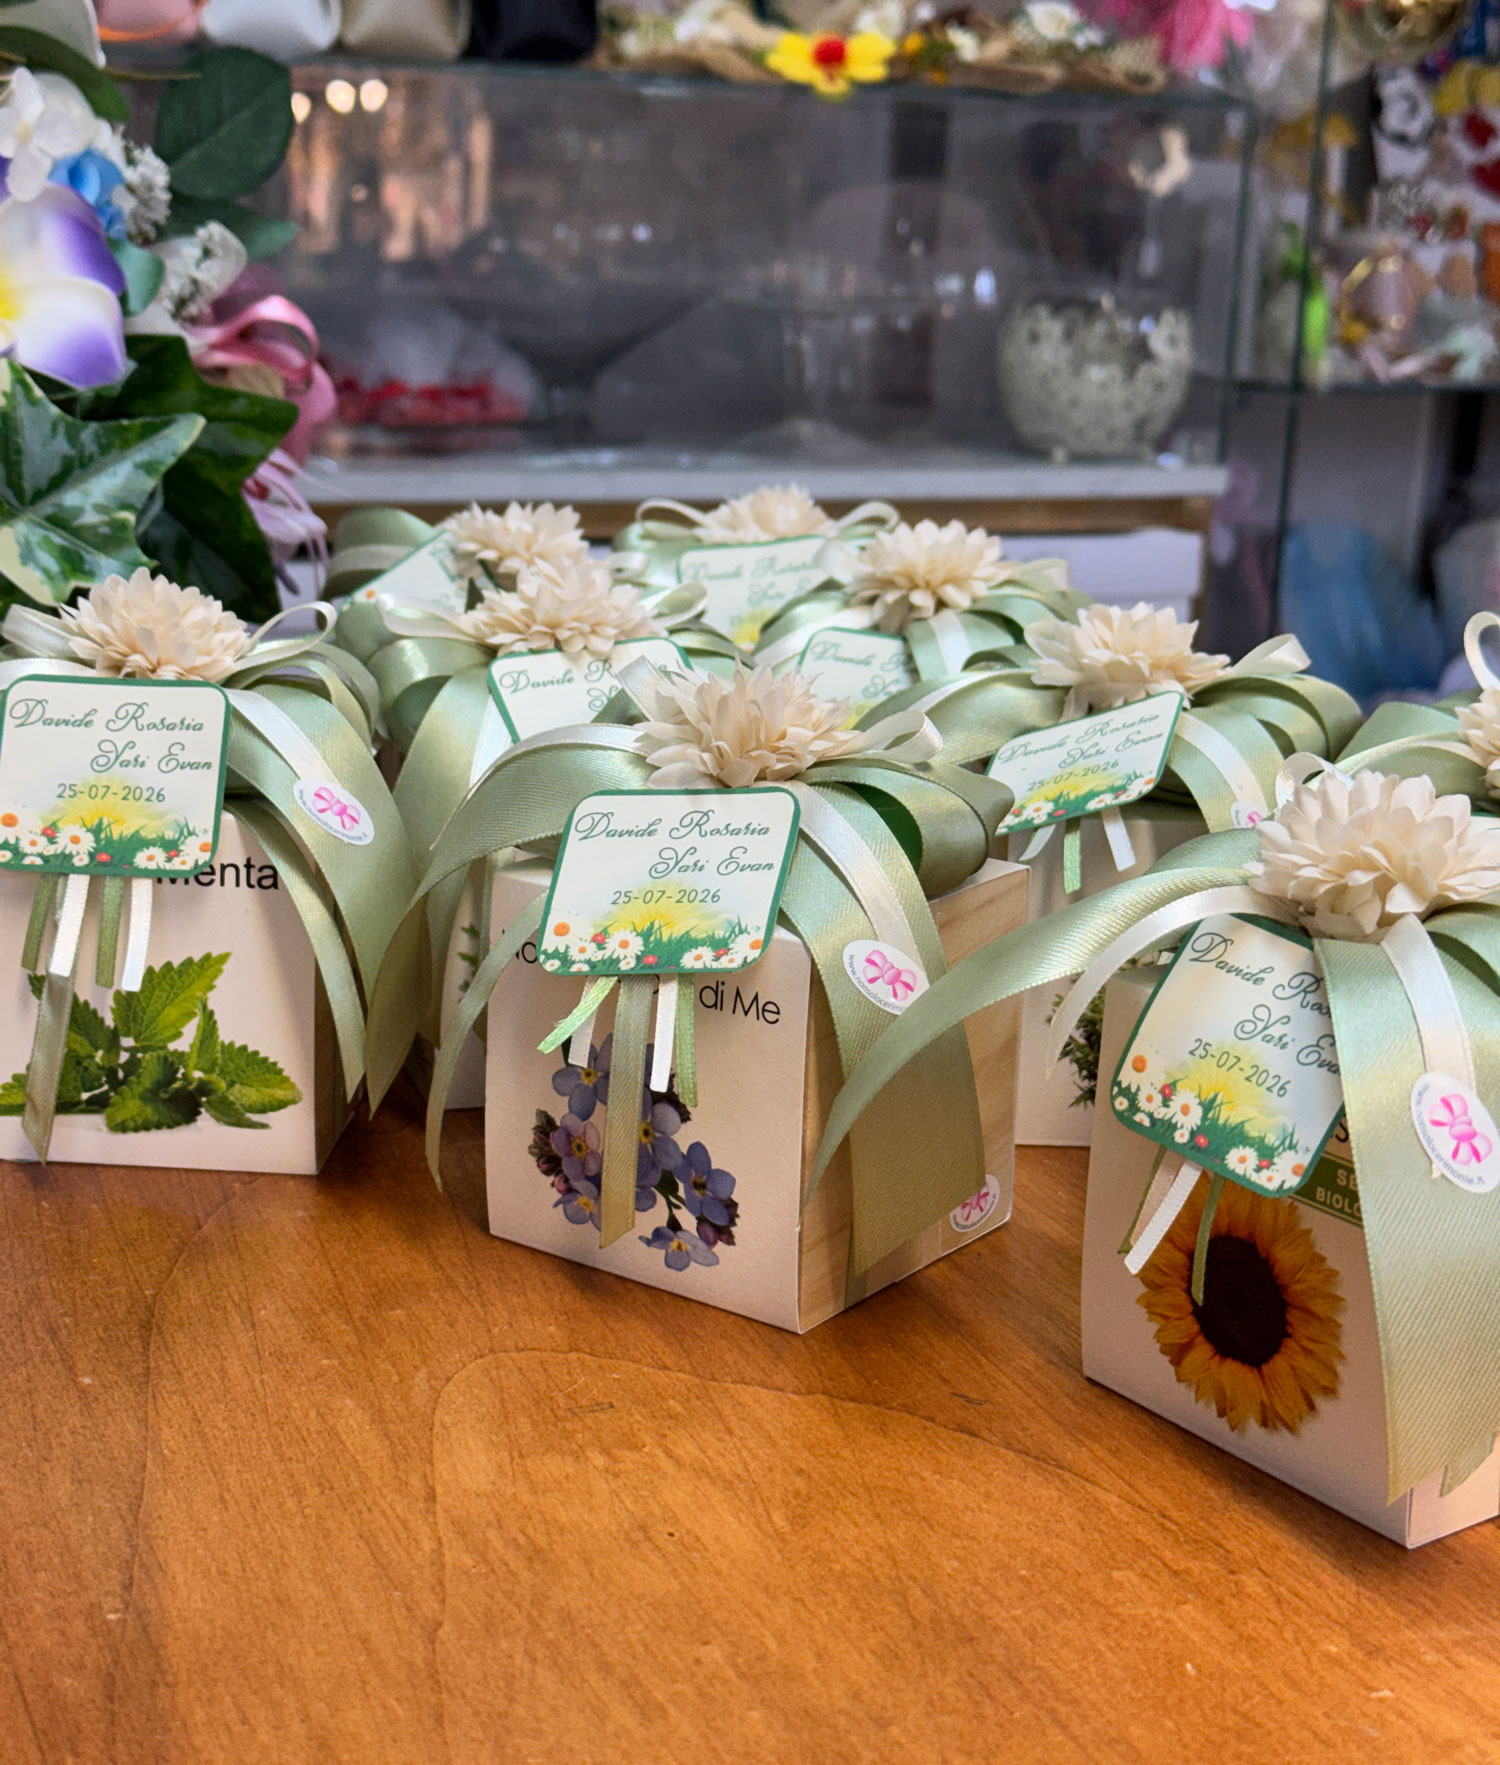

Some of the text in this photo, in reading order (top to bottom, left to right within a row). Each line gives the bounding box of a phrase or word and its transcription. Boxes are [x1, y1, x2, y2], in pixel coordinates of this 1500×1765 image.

[499, 667, 576, 695] Davide
[9, 698, 206, 733] Davide Rosaria
[90, 738, 213, 774] Yari Evan
[997, 734, 1071, 765] Davide
[1026, 758, 1120, 793] 25-07-2026
[56, 783, 166, 803] 25-07-2026
[574, 809, 771, 842] Davide Rosaria
[156, 856, 279, 890] enta
[648, 846, 775, 880] Yari Evan
[610, 888, 721, 906] 25-07-2026
[1190, 932, 1332, 1019] Davide Ros
[698, 979, 726, 1012] di
[731, 985, 781, 1025] Me
[1233, 1004, 1340, 1077] Yari Eva
[1188, 1037, 1292, 1099] 25-07-2026
[1336, 1168, 1358, 1191] SE
[1315, 1186, 1362, 1217] BIOLO
